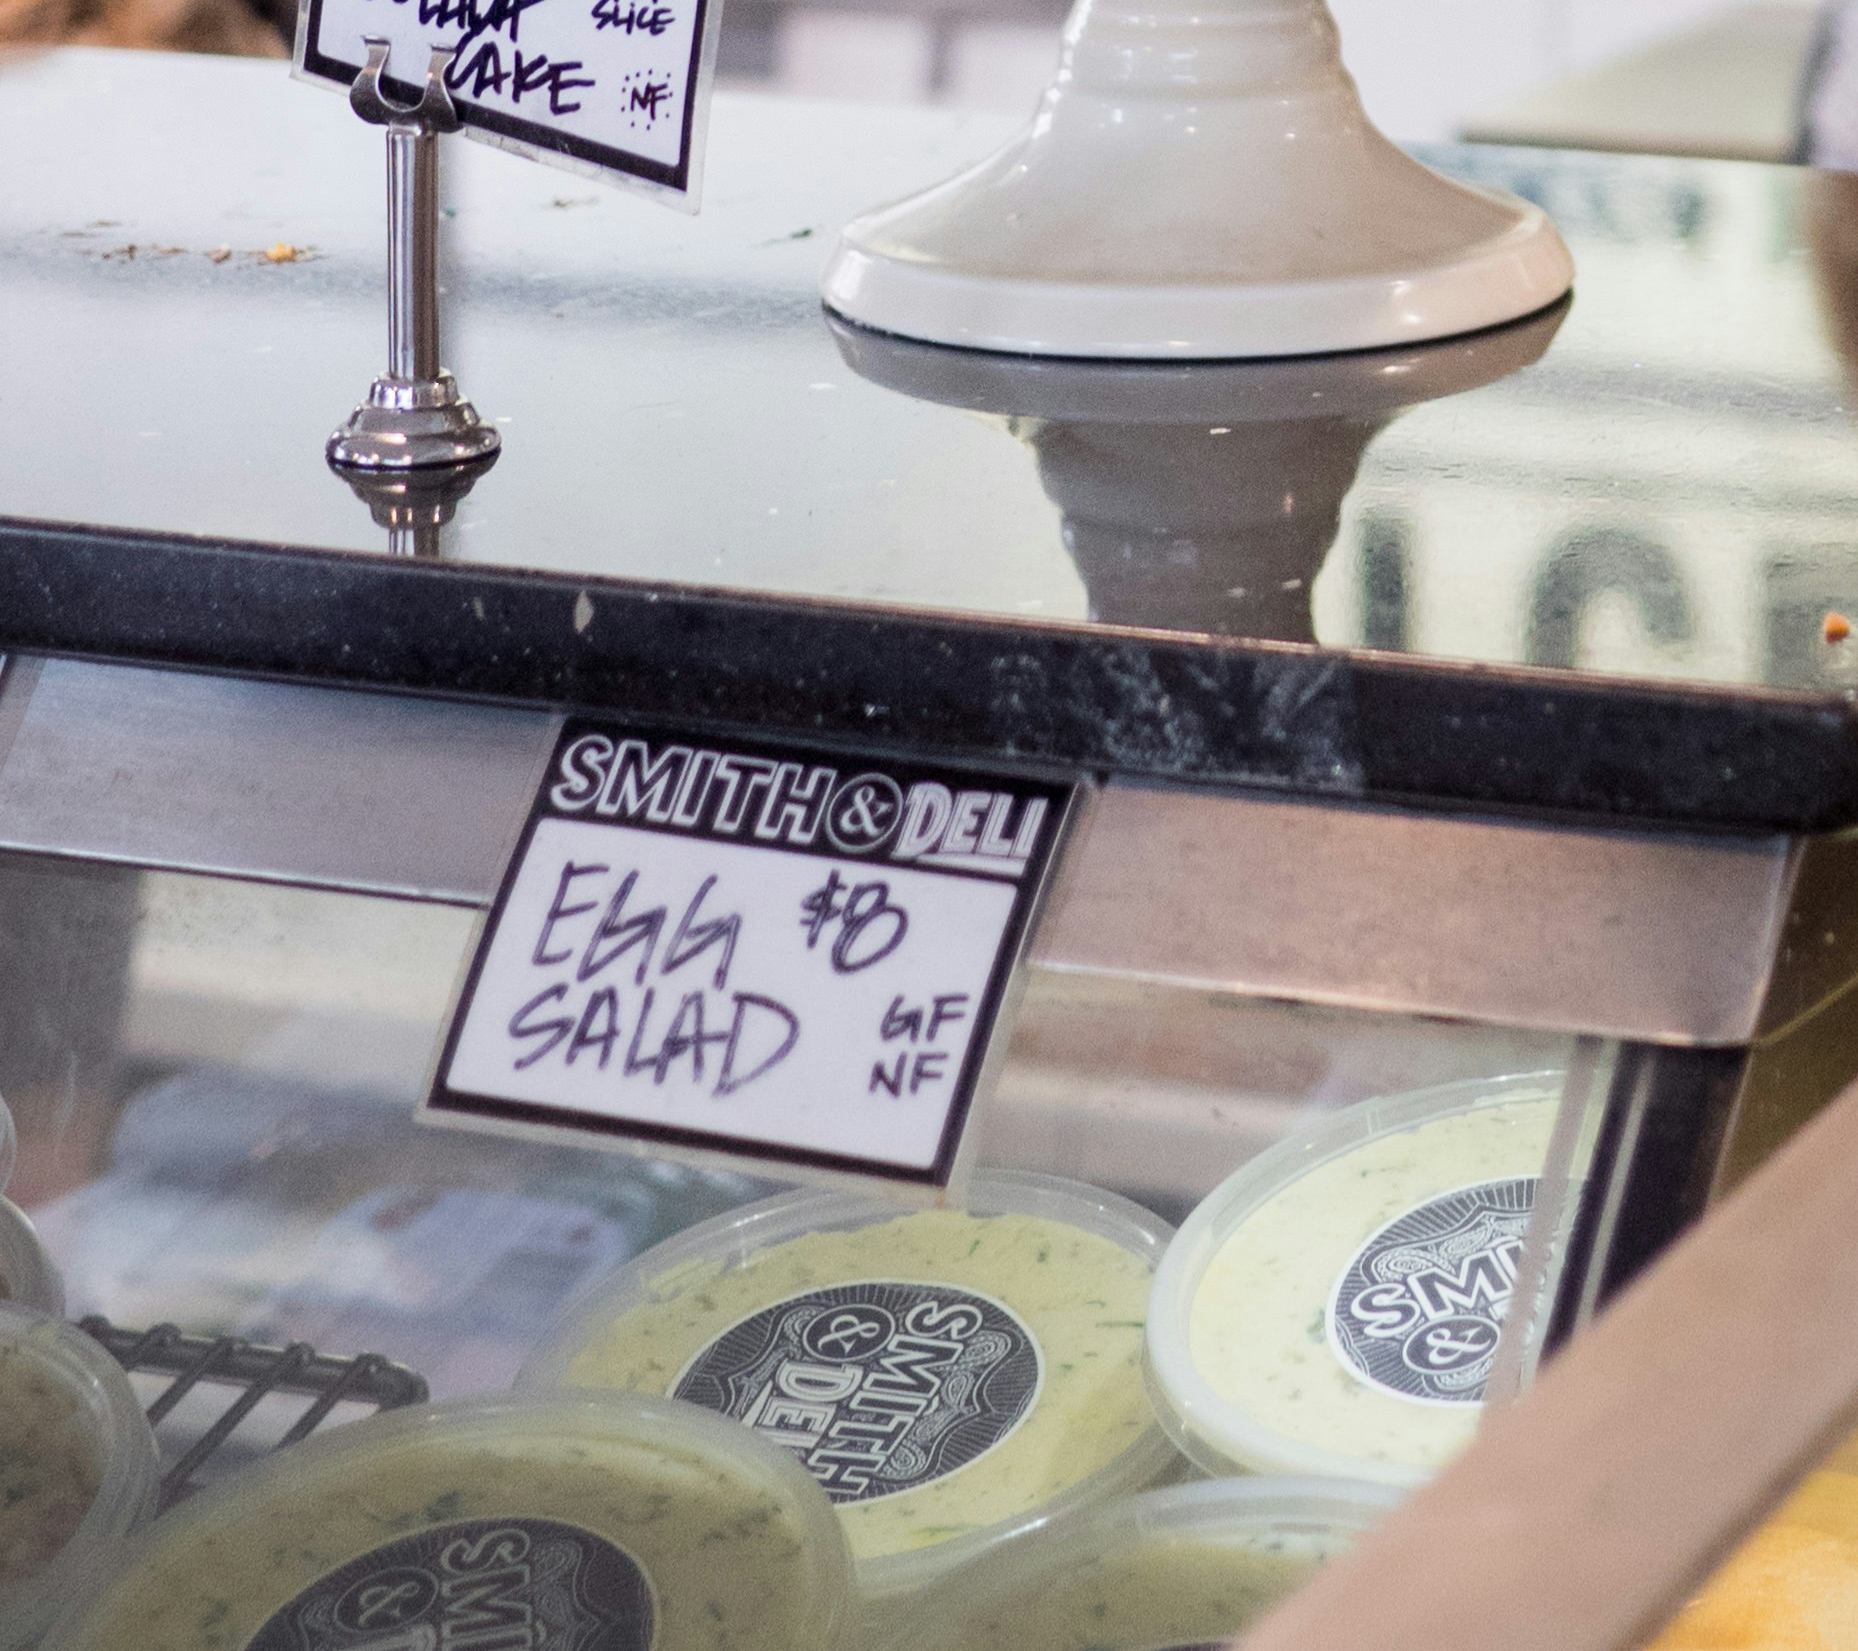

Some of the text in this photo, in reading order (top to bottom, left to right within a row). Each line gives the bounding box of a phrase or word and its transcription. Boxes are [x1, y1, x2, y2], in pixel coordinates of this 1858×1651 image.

[444, 32, 596, 117] CAKE
[549, 733, 837, 845] SMITH
[891, 780, 1051, 865] DELI
[530, 861, 910, 991] EGG $8
[507, 981, 802, 1099] SALAD
[866, 1050, 949, 1102] NF
[806, 1299, 984, 1495] SMITH
